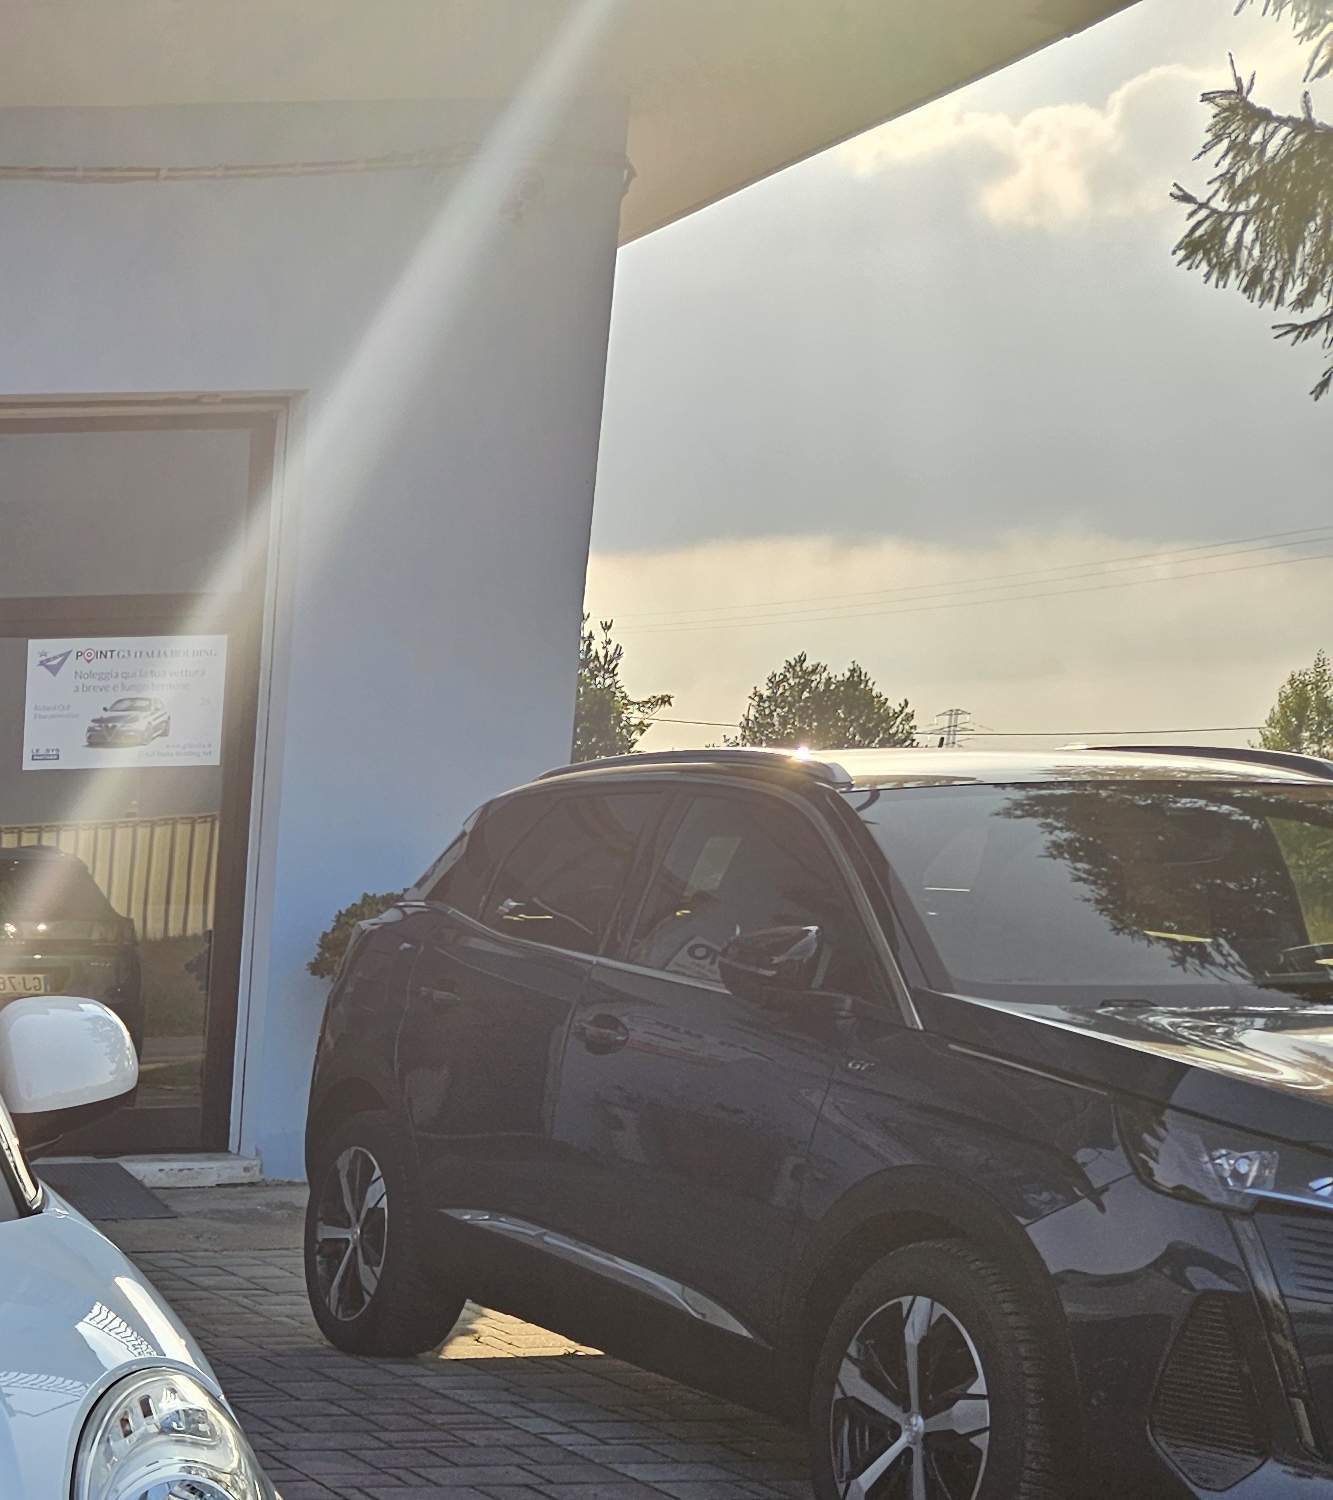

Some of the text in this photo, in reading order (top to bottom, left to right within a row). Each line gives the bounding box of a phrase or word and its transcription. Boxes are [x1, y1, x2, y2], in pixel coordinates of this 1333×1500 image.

[116, 649, 131, 660] G3
[134, 649, 168, 659] ITALIA
[74, 669, 119, 681] Noleggia
[121, 669, 137, 680] qui
[168, 668, 206, 678] vettura
[73, 685, 80, 693] a
[81, 683, 110, 693] breve
[120, 682, 149, 693] lungo
